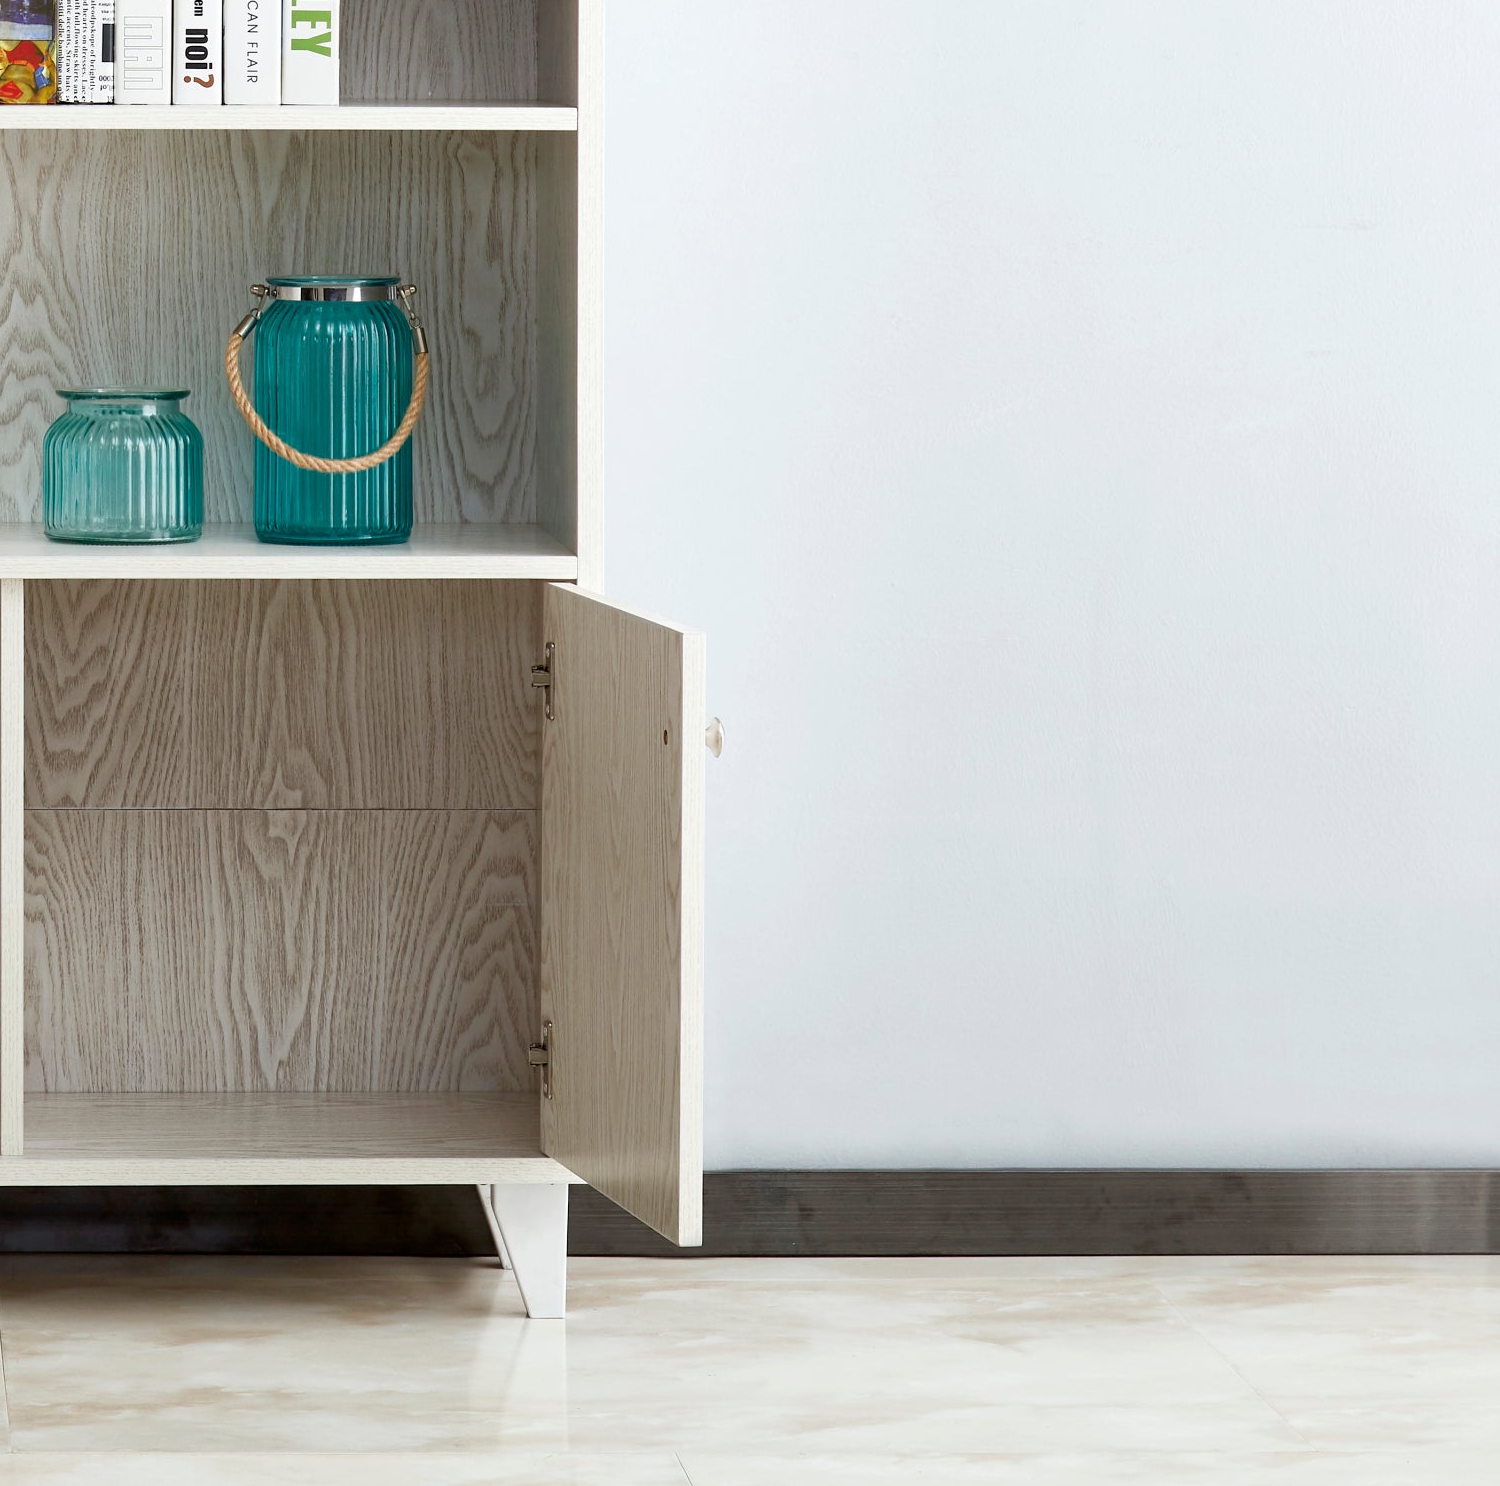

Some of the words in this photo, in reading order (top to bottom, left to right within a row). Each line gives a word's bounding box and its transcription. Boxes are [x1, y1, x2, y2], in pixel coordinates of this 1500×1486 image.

[82, 35, 87, 44] on
[183, 28, 215, 89] noi?
[246, 41, 260, 84] FLAIR
